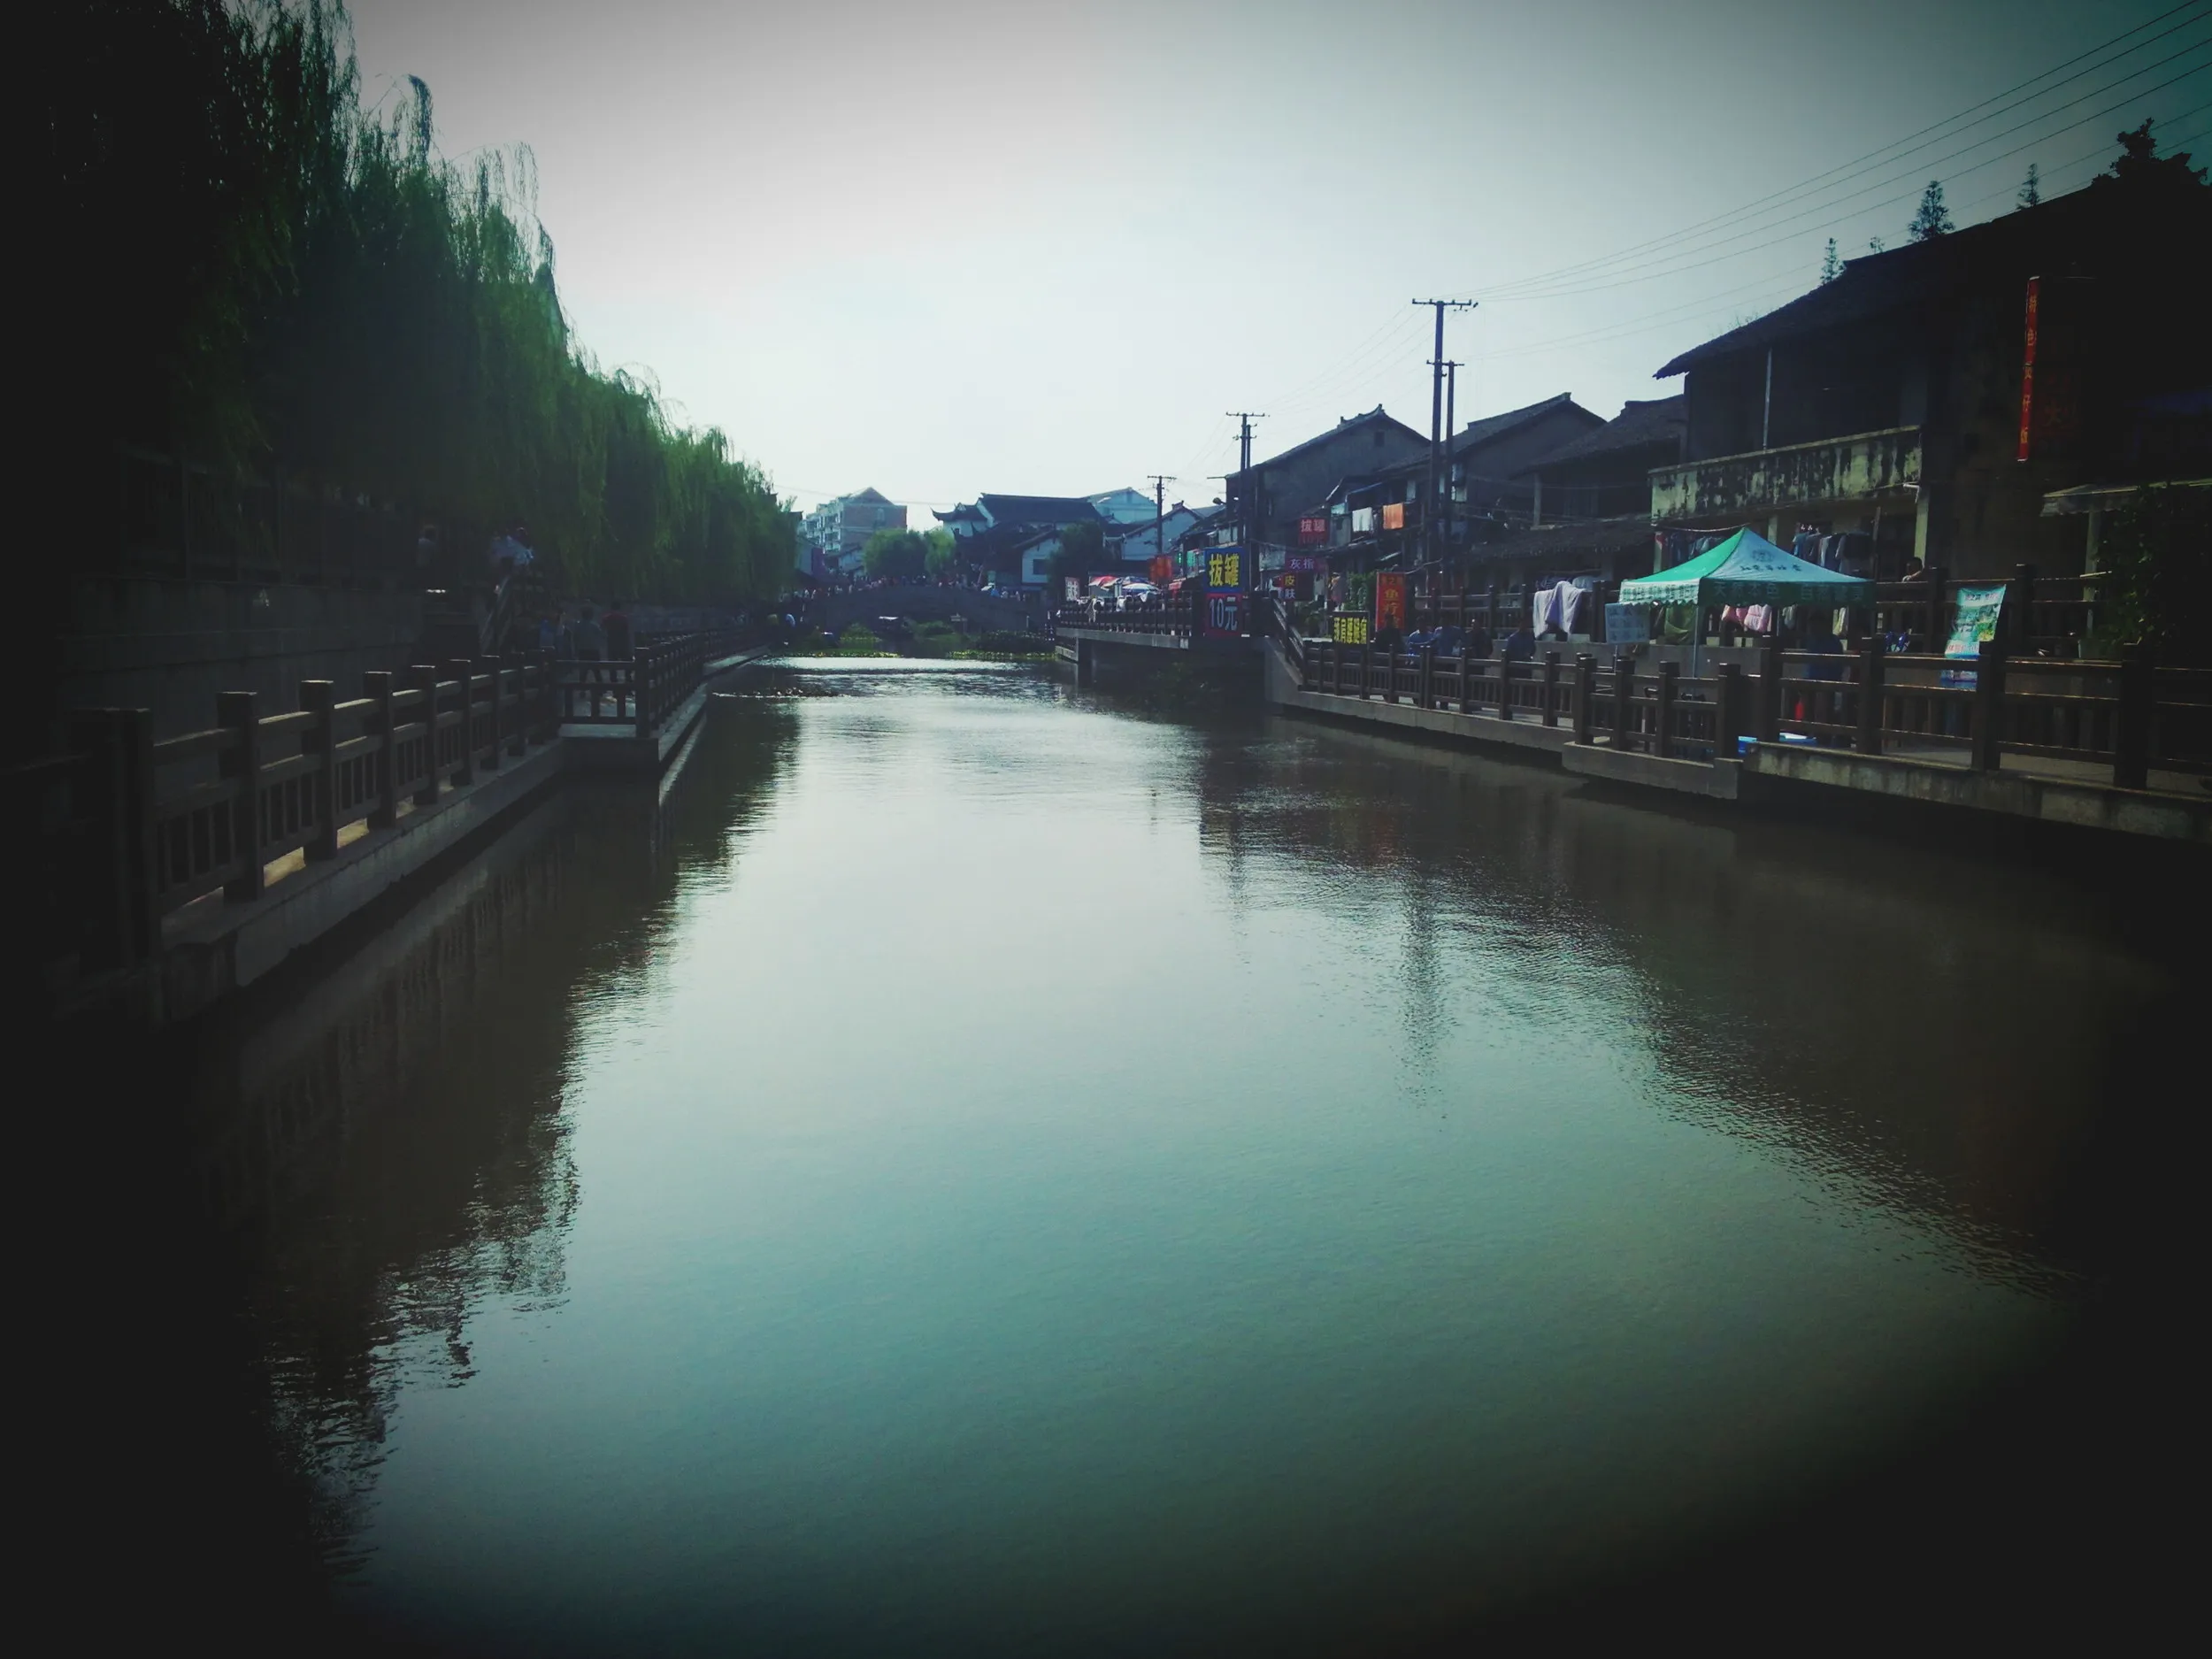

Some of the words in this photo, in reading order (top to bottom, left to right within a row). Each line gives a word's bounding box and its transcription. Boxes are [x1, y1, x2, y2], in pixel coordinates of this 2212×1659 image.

[1301, 518, 1325, 533] 拔罐
[1209, 553, 1239, 587] 拔罐
[1209, 596, 1238, 631] 10元
